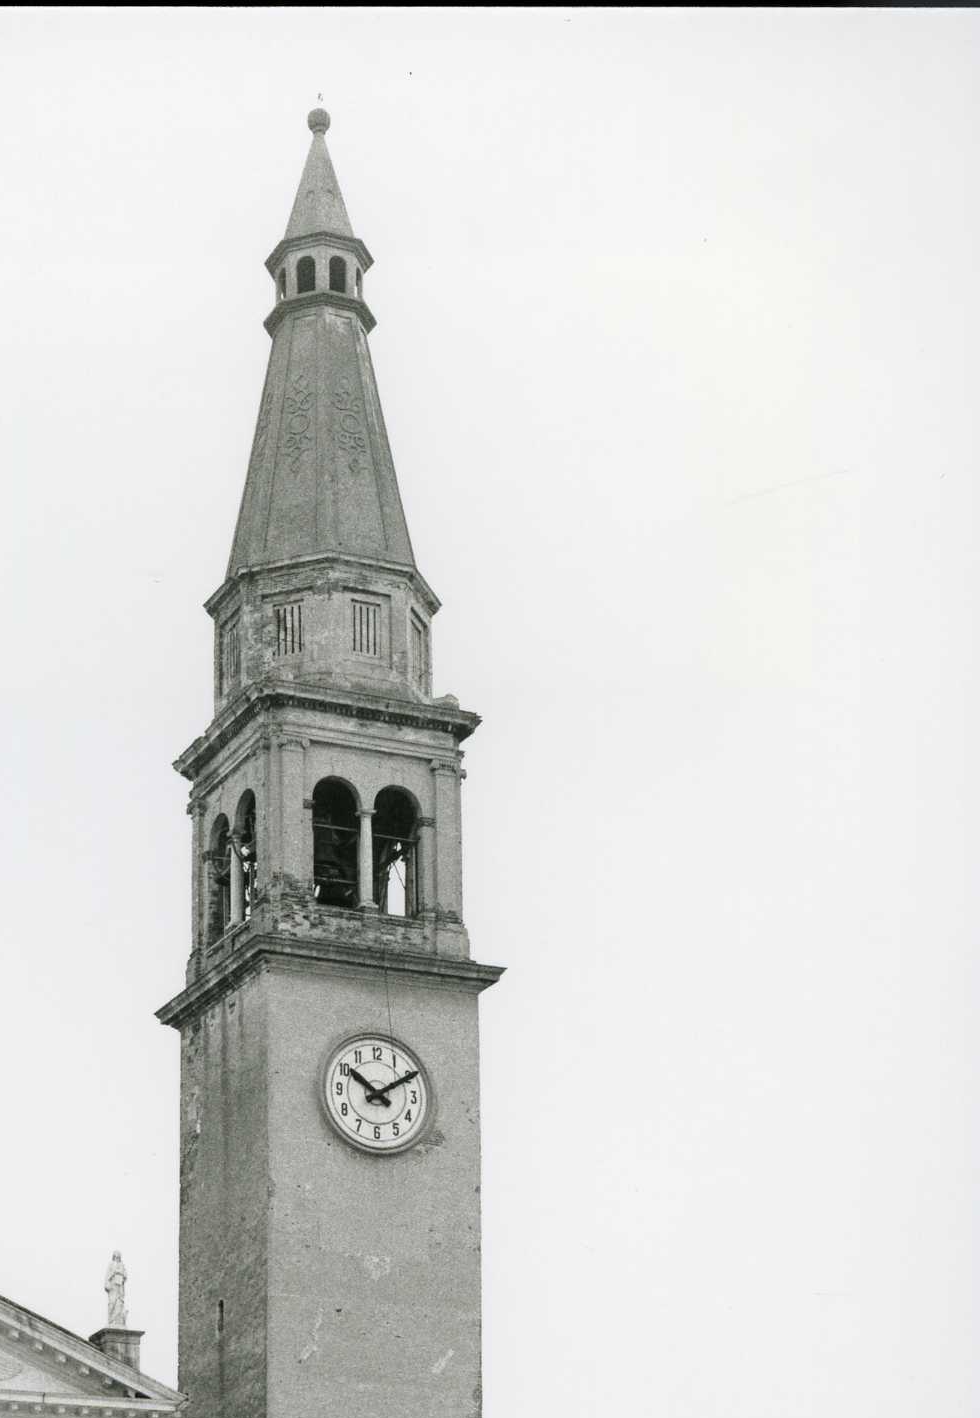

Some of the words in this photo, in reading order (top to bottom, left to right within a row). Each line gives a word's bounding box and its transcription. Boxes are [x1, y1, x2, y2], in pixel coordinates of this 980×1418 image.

[354, 1050, 361, 1063] 11
[372, 1047, 382, 1060] 12
[392, 1054, 396, 1068] 1
[340, 1063, 349, 1076] 10
[336, 1083, 343, 1095] 9
[410, 1091, 417, 1104] 3
[341, 1103, 348, 1116] 8
[404, 1109, 412, 1122] 4
[355, 1119, 362, 1132] 7
[393, 1123, 399, 1136] 5
[374, 1126, 380, 1139] 6
